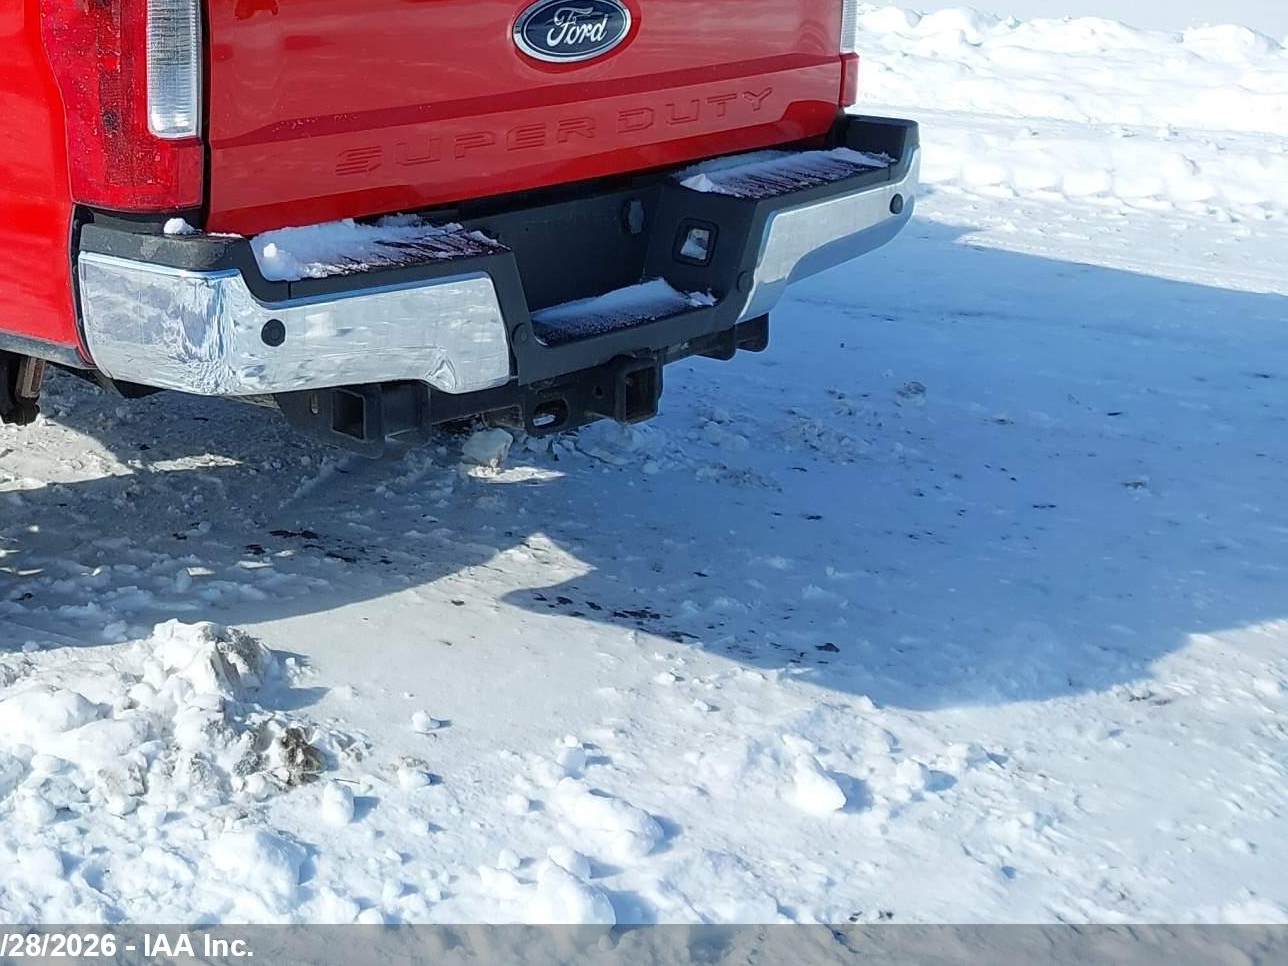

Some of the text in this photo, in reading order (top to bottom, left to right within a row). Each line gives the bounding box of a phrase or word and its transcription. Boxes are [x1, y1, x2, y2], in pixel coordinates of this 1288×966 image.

[545, 5, 609, 47] Ford
[335, 86, 774, 177] SUPER DUTY
